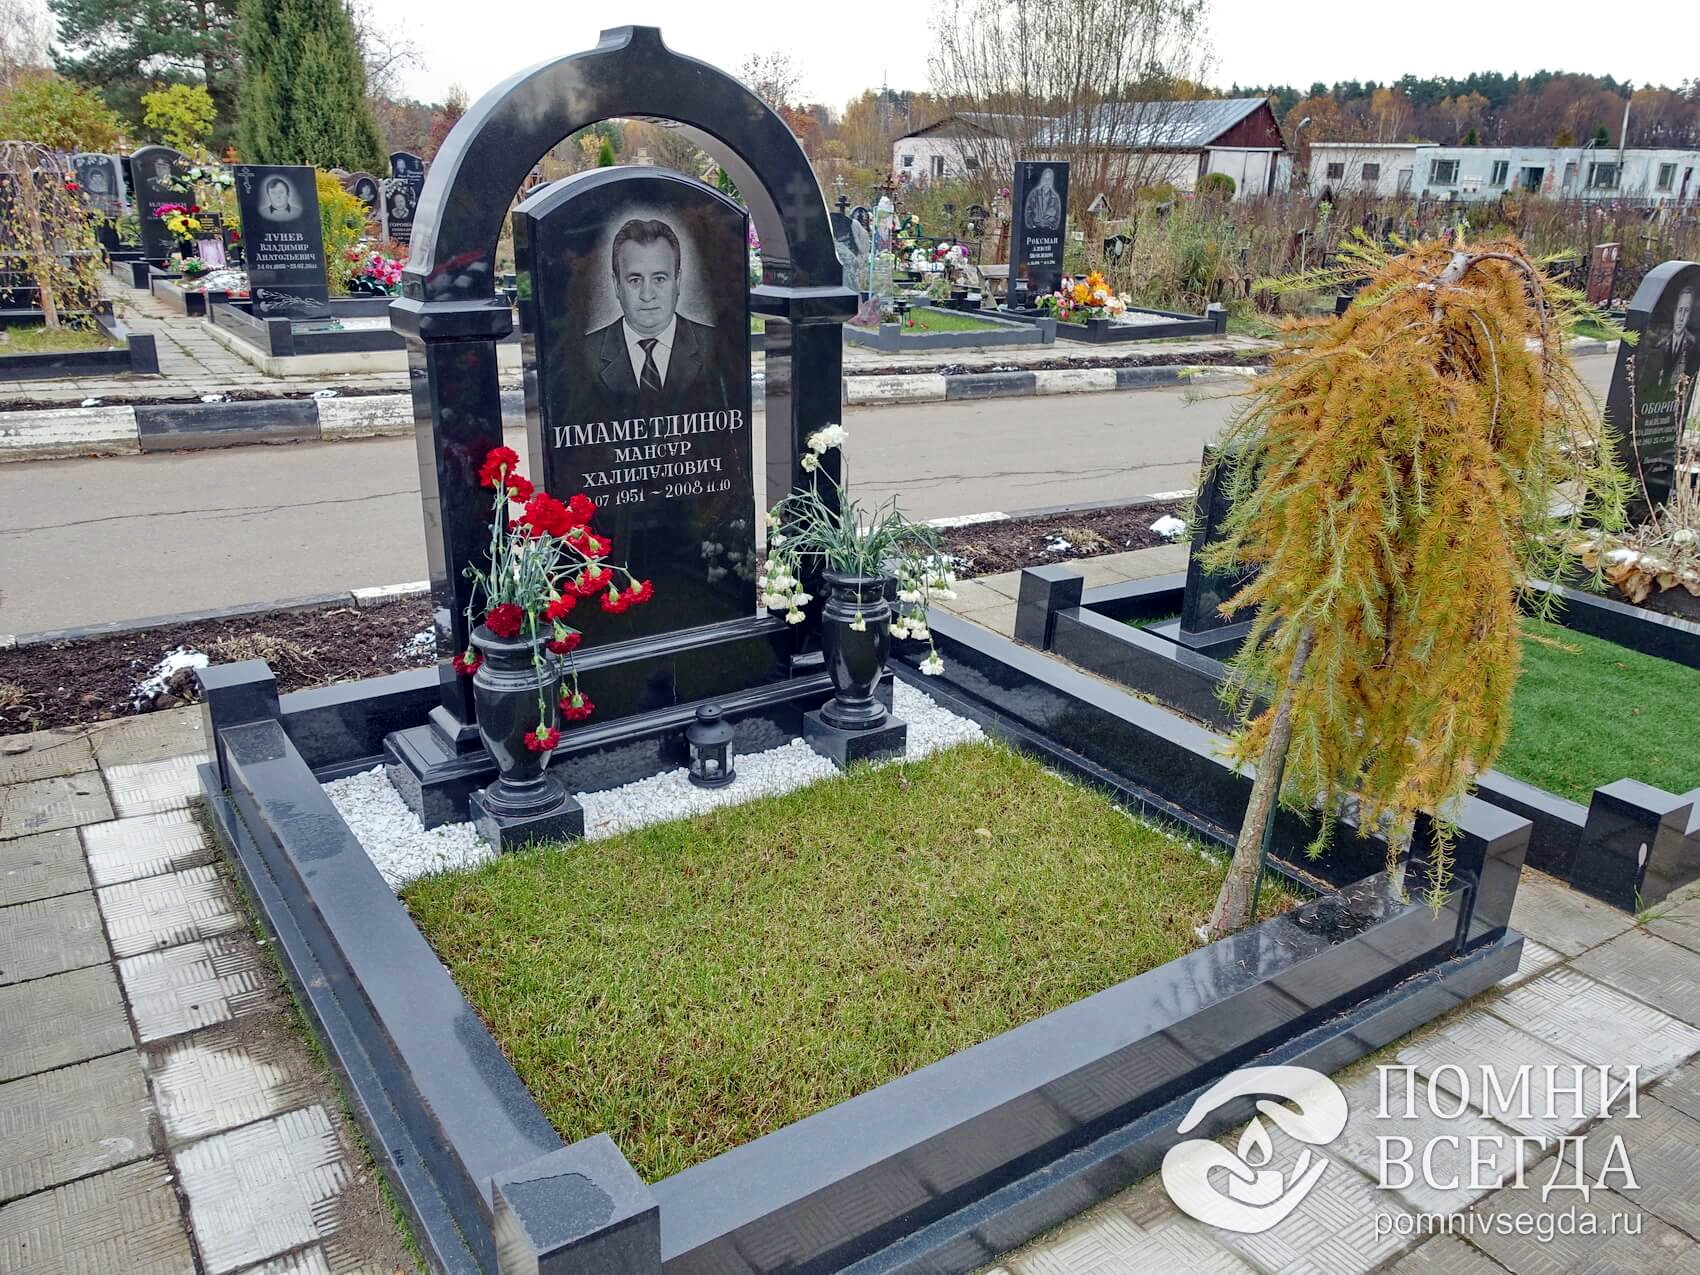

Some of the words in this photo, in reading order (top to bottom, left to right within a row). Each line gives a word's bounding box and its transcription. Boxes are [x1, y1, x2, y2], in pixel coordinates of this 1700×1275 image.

[264, 233, 304, 241] ЛУНЕВ
[553, 409, 743, 448] ИМАМЕТДИНОВ
[615, 441, 691, 463] МАНСУР
[581, 457, 722, 488] ХАЛИЛУЛОВИЧ
[615, 488, 645, 505] 1951
[665, 480, 703, 498] 2008
